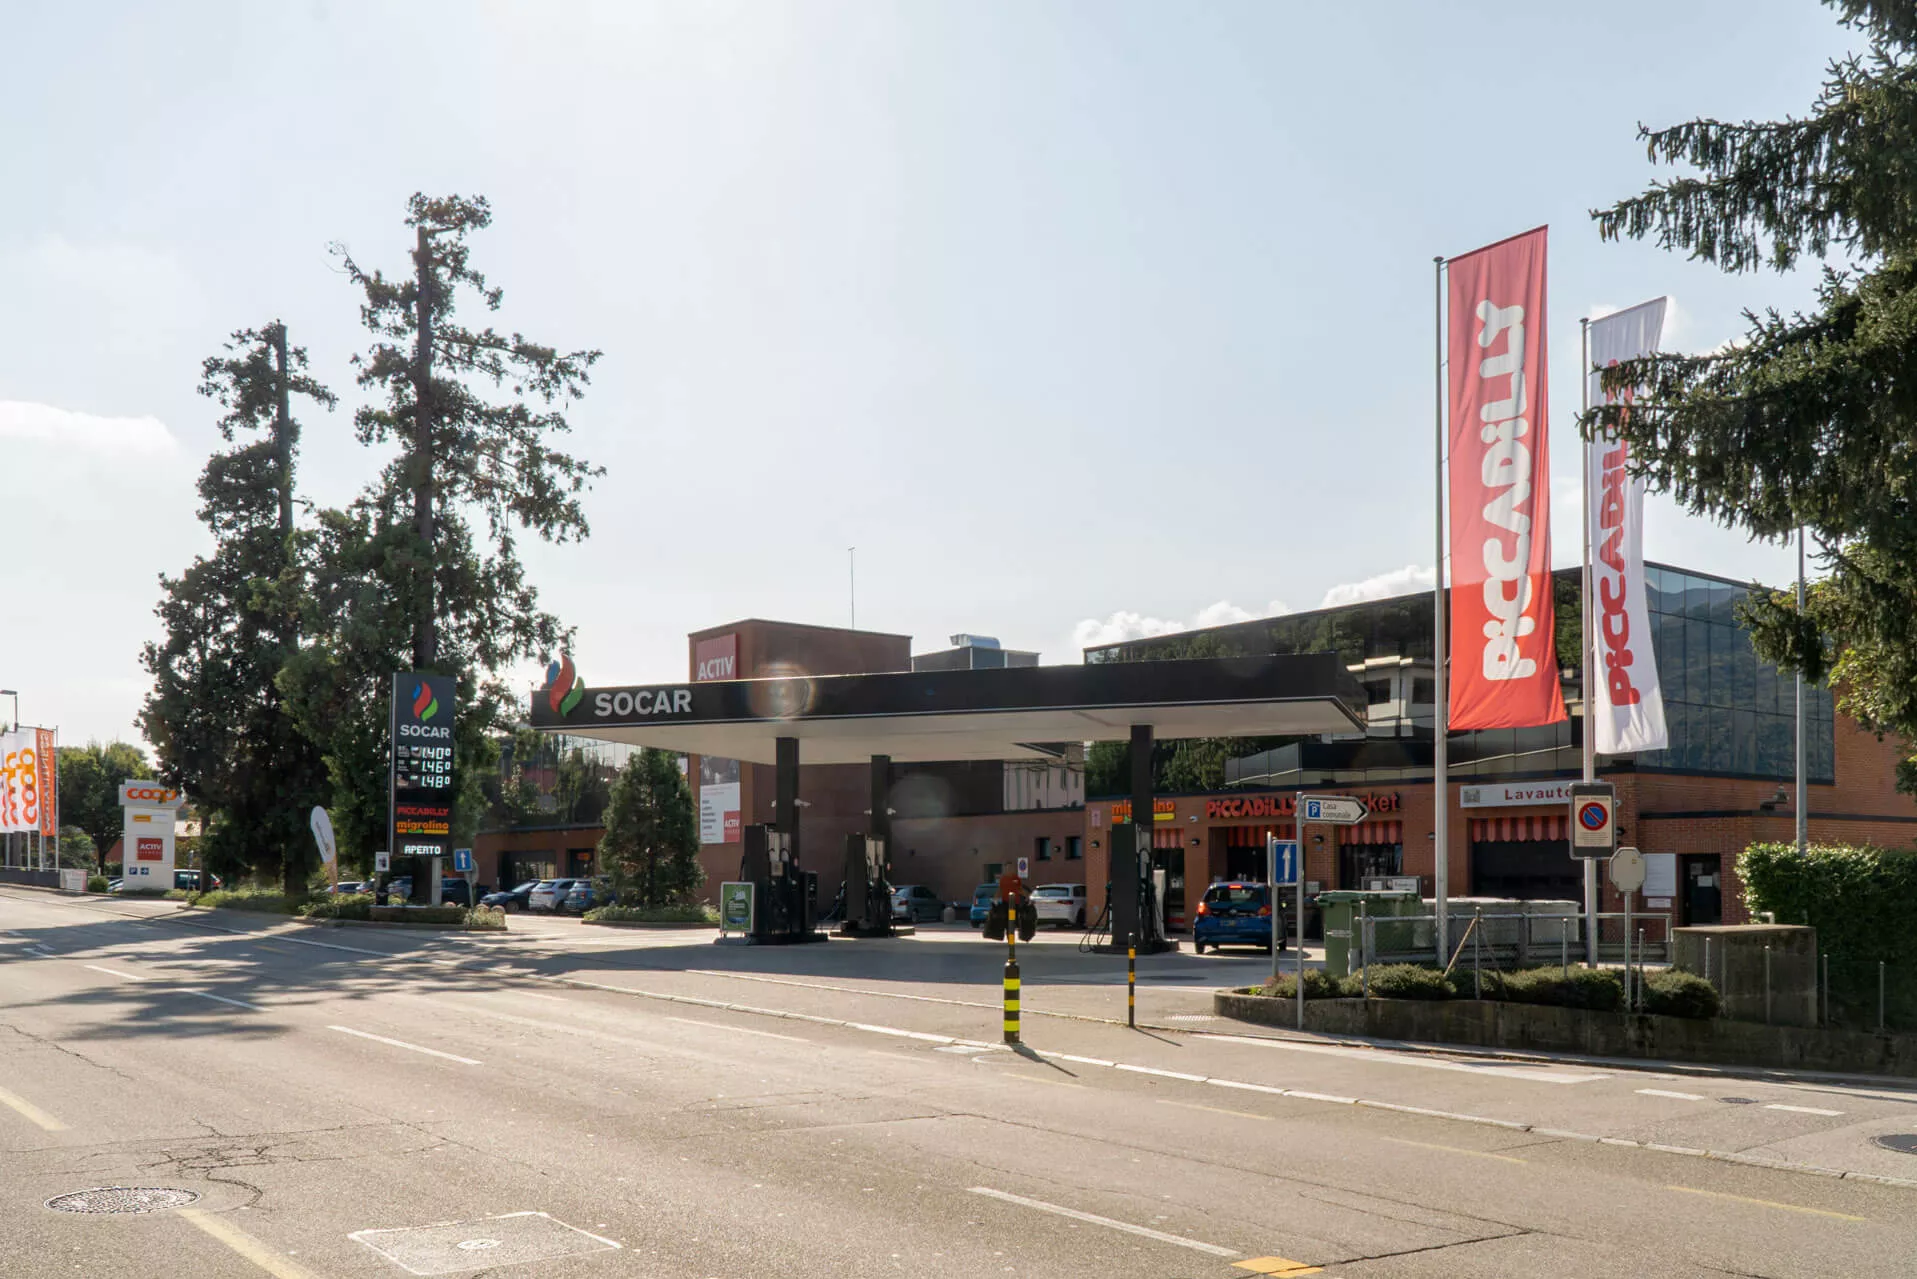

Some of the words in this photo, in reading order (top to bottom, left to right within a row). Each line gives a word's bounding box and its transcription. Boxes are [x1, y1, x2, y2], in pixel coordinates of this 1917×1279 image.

[697, 656, 735, 681] ACTIV
[594, 689, 693, 717] SOCAR
[400, 724, 450, 738] SOCAR
[126, 787, 177, 804] coop
[1322, 802, 1337, 810] Casa
[396, 819, 449, 831] migrolino
[404, 844, 441, 855] APERTO
